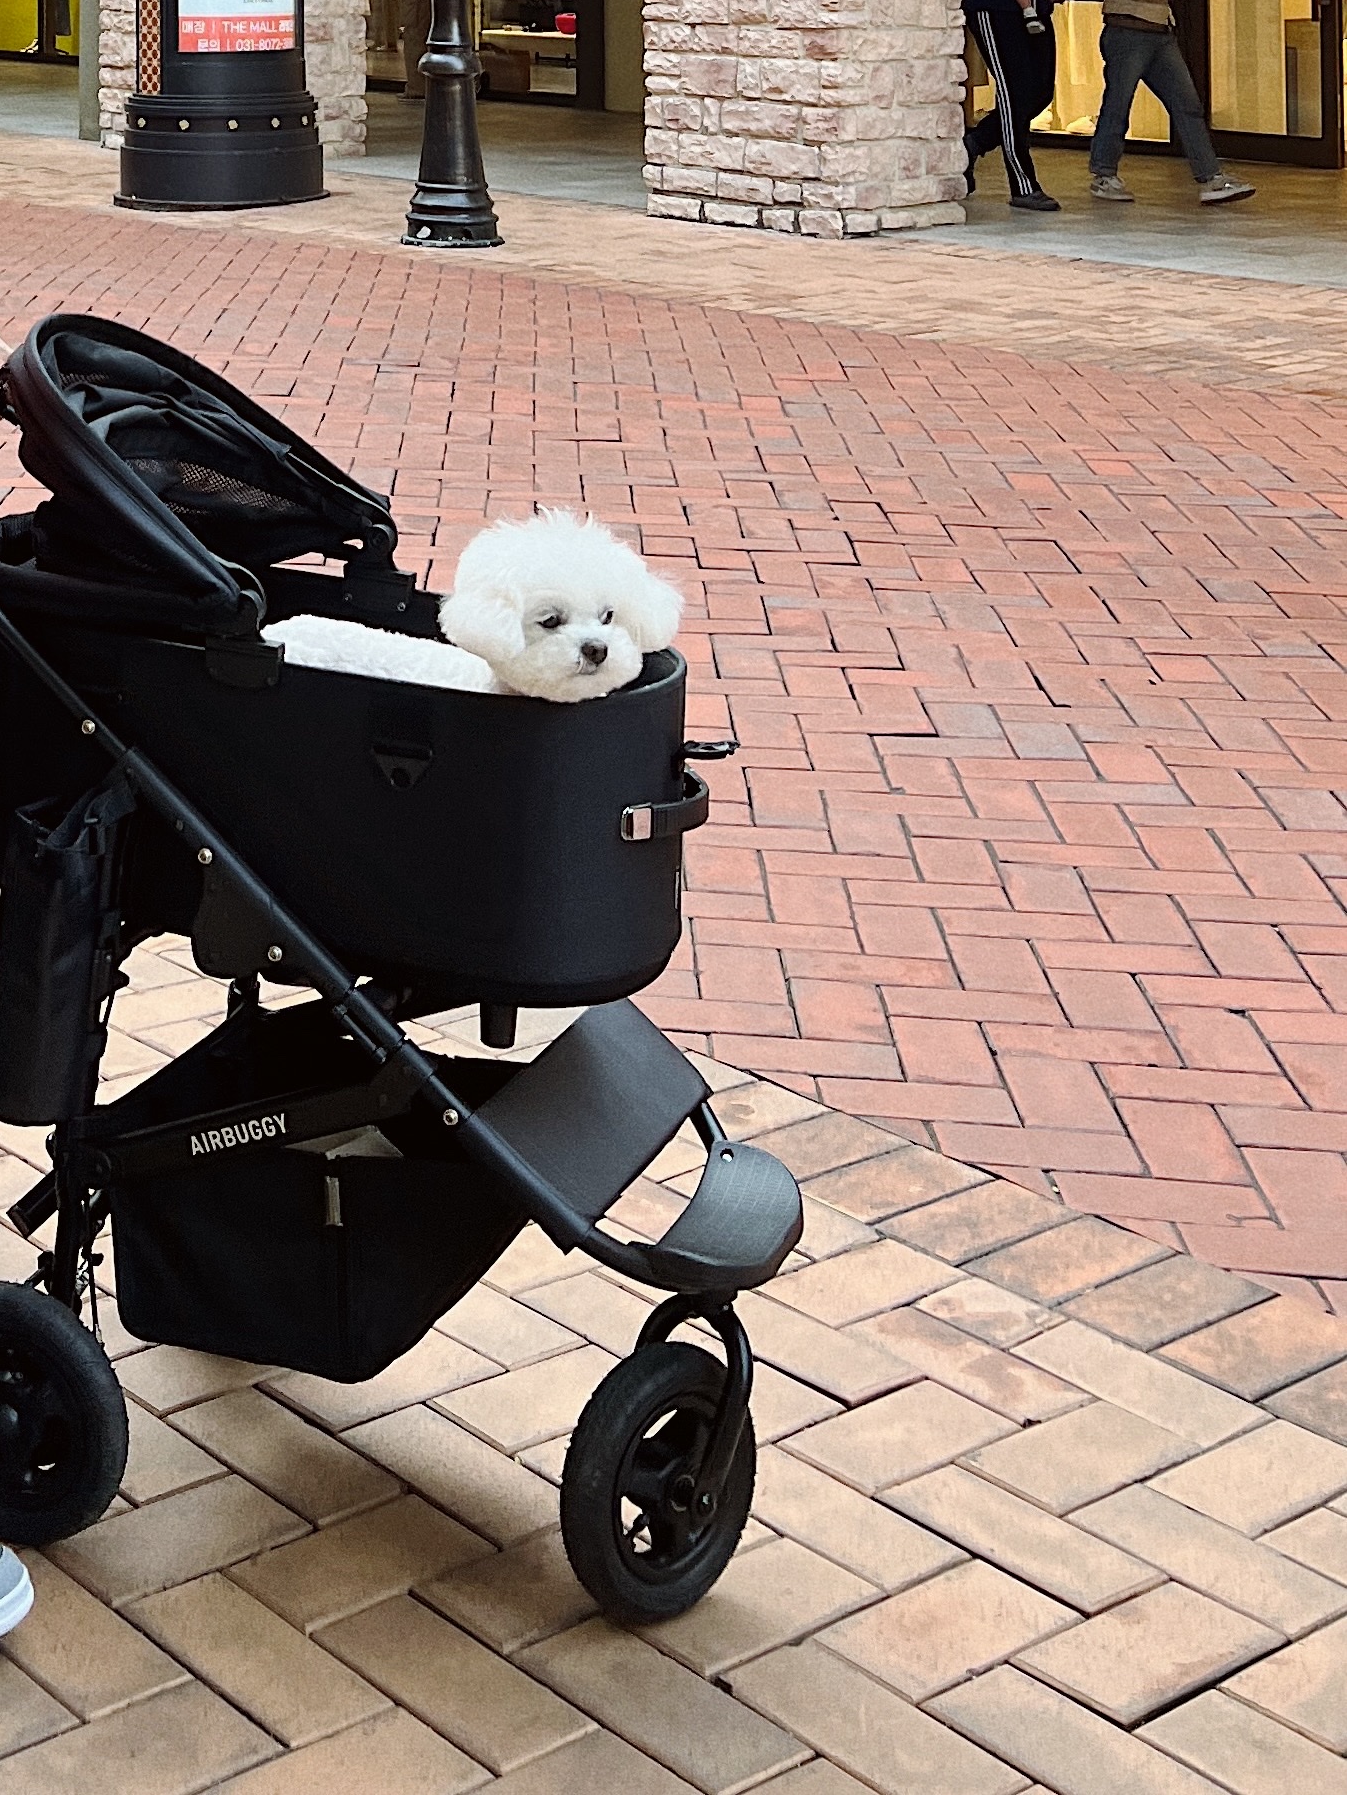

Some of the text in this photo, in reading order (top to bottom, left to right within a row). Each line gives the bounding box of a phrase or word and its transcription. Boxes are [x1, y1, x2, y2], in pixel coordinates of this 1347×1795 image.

[181, 20, 205, 34] 매장
[222, 20, 247, 34] THE
[249, 20, 277, 34] MALL
[197, 38, 220, 52] 문의
[190, 1112, 287, 1156] AIRBUGGY
